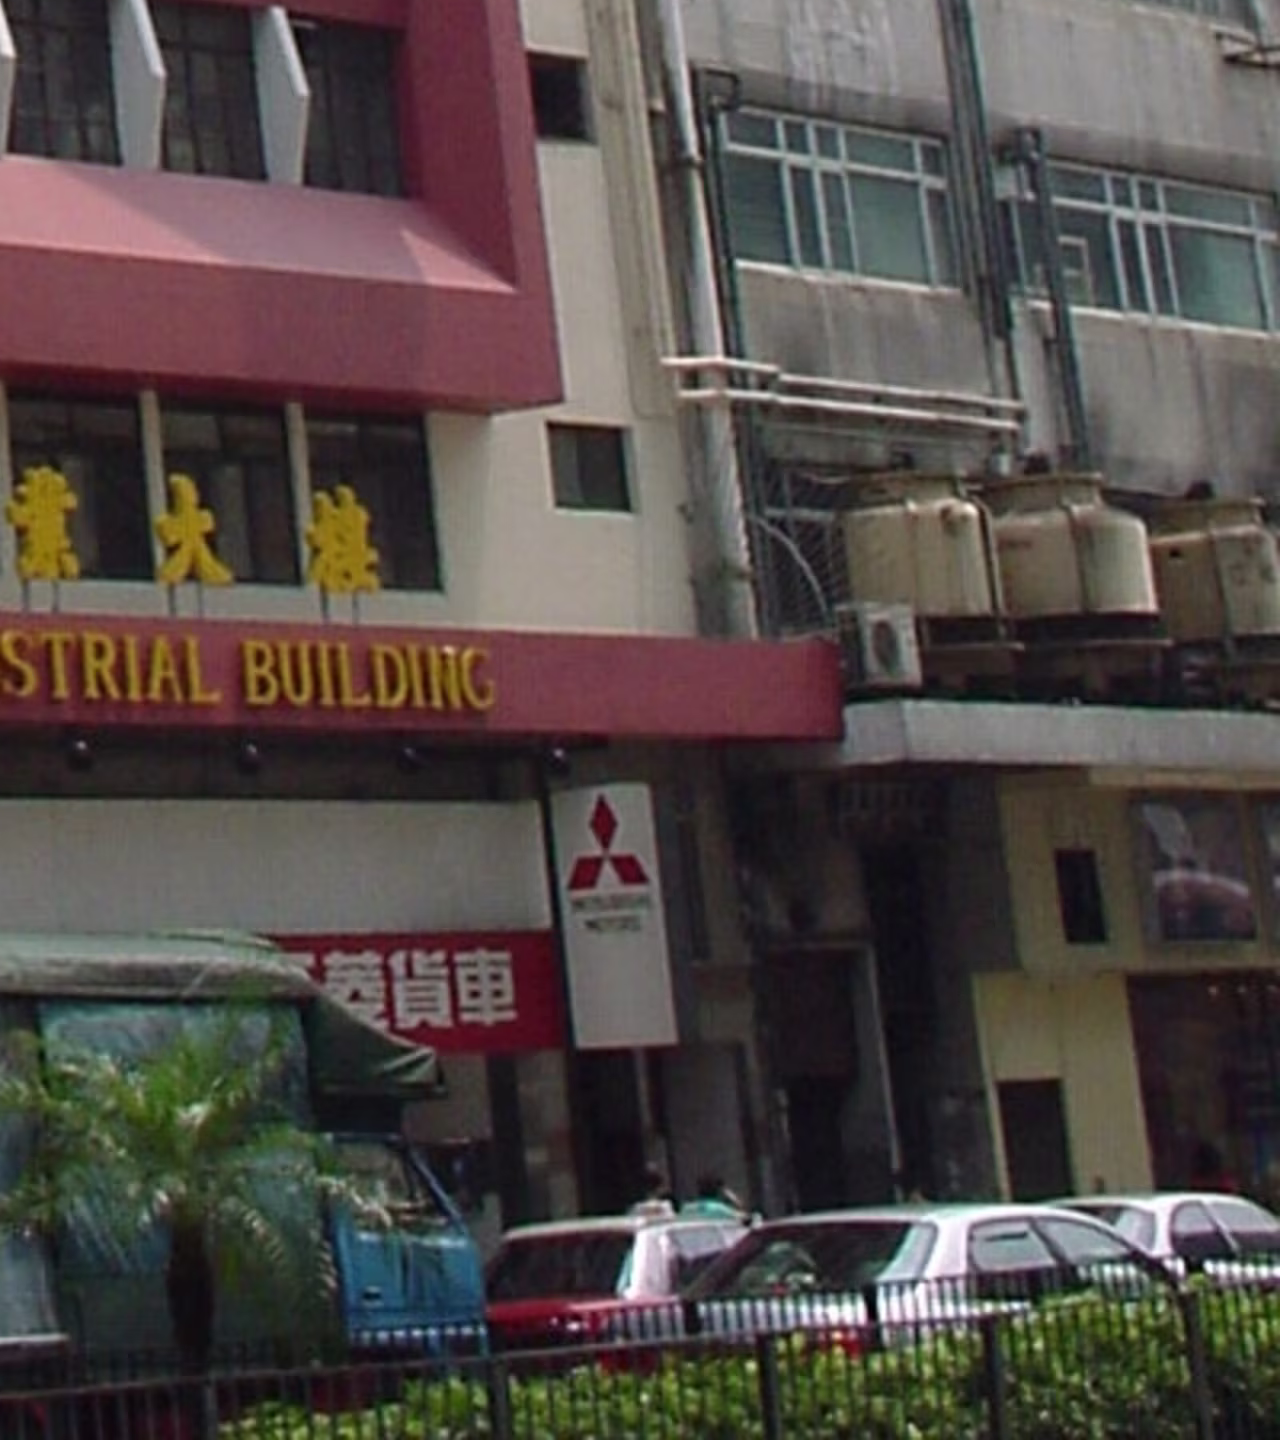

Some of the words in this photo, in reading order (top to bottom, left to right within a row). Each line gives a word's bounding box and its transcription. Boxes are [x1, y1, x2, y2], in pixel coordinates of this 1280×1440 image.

[241, 640, 496, 711] BUILDING
[280, 948, 519, 1028] 菱貨車
